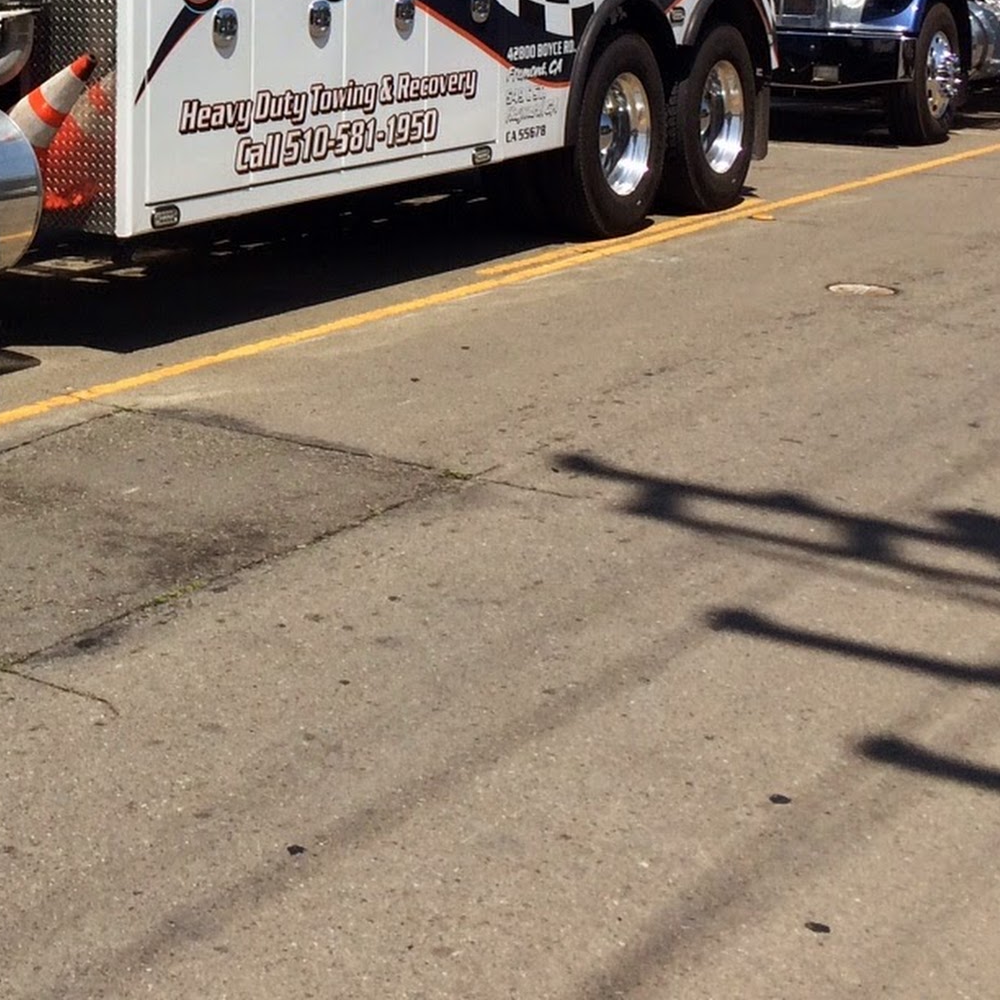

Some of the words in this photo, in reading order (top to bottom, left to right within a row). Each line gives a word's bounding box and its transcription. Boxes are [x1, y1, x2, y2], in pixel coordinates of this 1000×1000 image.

[537, 41, 562, 58] BOYCE
[549, 58, 563, 76] CA
[178, 98, 253, 135] Heavy
[253, 89, 309, 125] Duty
[309, 80, 377, 115] Towing
[379, 74, 396, 107] &
[396, 70, 478, 103] Recovery
[235, 132, 283, 175] Call
[282, 107, 439, 167] 510-581-1950
[505, 130, 517, 143] CA
